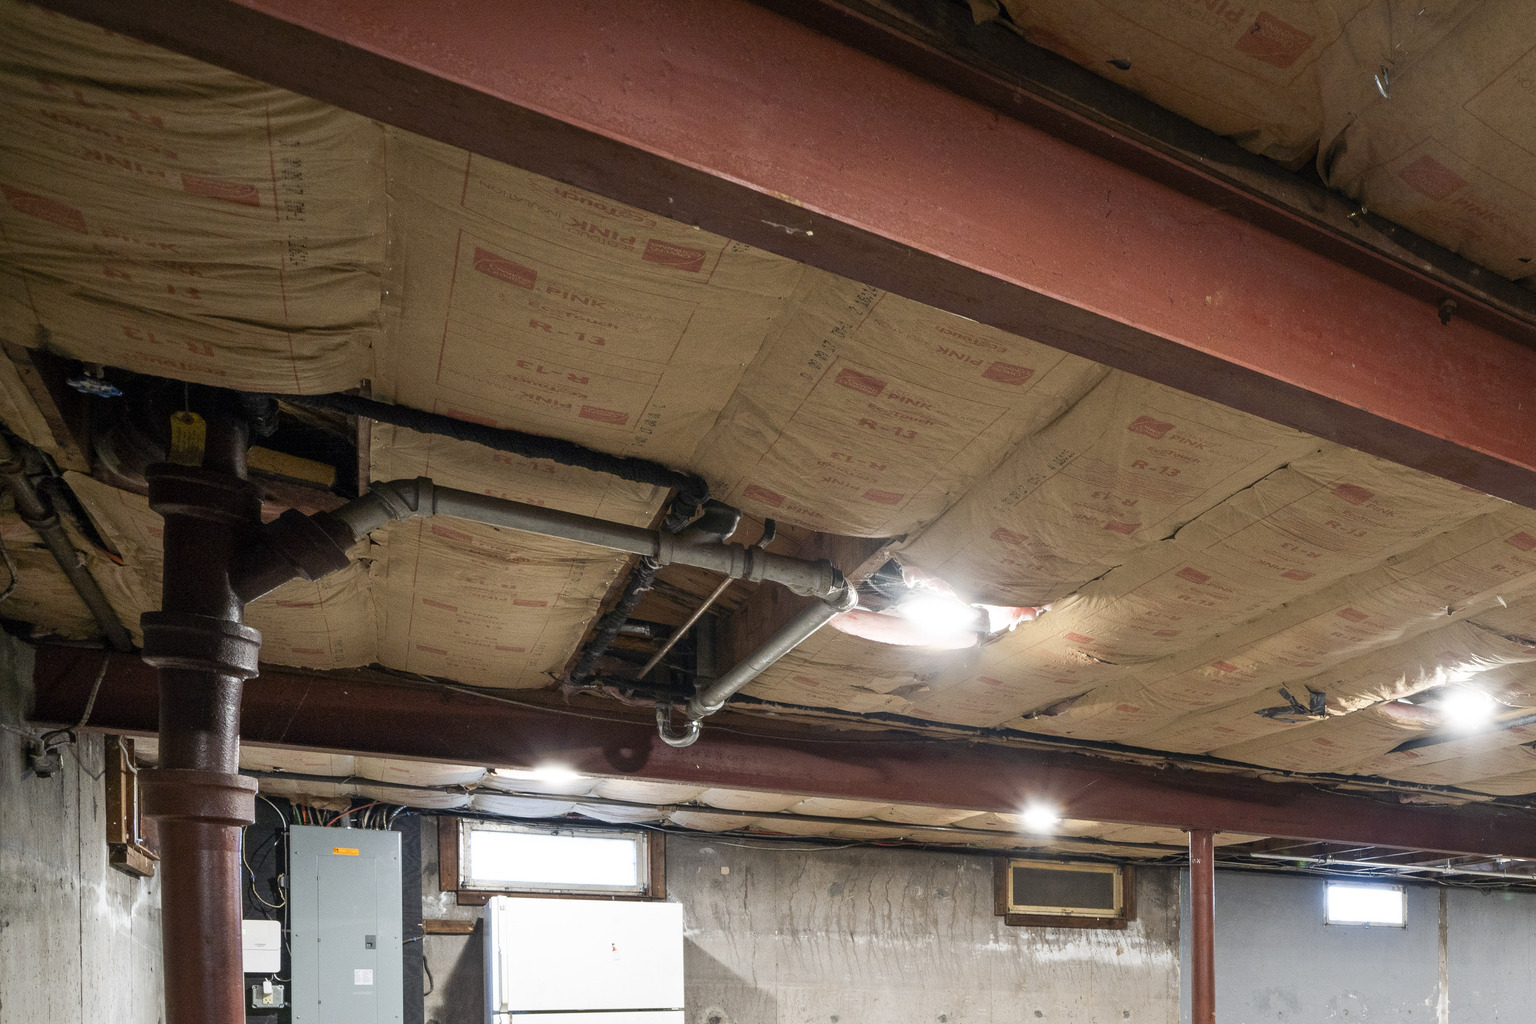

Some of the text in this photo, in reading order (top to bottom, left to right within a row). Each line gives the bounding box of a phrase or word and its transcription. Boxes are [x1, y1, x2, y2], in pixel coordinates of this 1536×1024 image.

[569, 217, 637, 246] PINK
[545, 285, 607, 310] PINK
[528, 317, 608, 348] R-13
[937, 343, 985, 368] PINK
[515, 358, 591, 387] R-13
[886, 391, 936, 412] PINK
[857, 416, 920, 441] R-13
[1167, 432, 1206, 451] PINK
[491, 452, 558, 476] R-13
[829, 450, 889, 473] R-13
[1130, 458, 1183, 479] R-13
[1090, 490, 1140, 508] R-13
[1325, 518, 1369, 540] R-13
[1281, 541, 1324, 560] R-13
